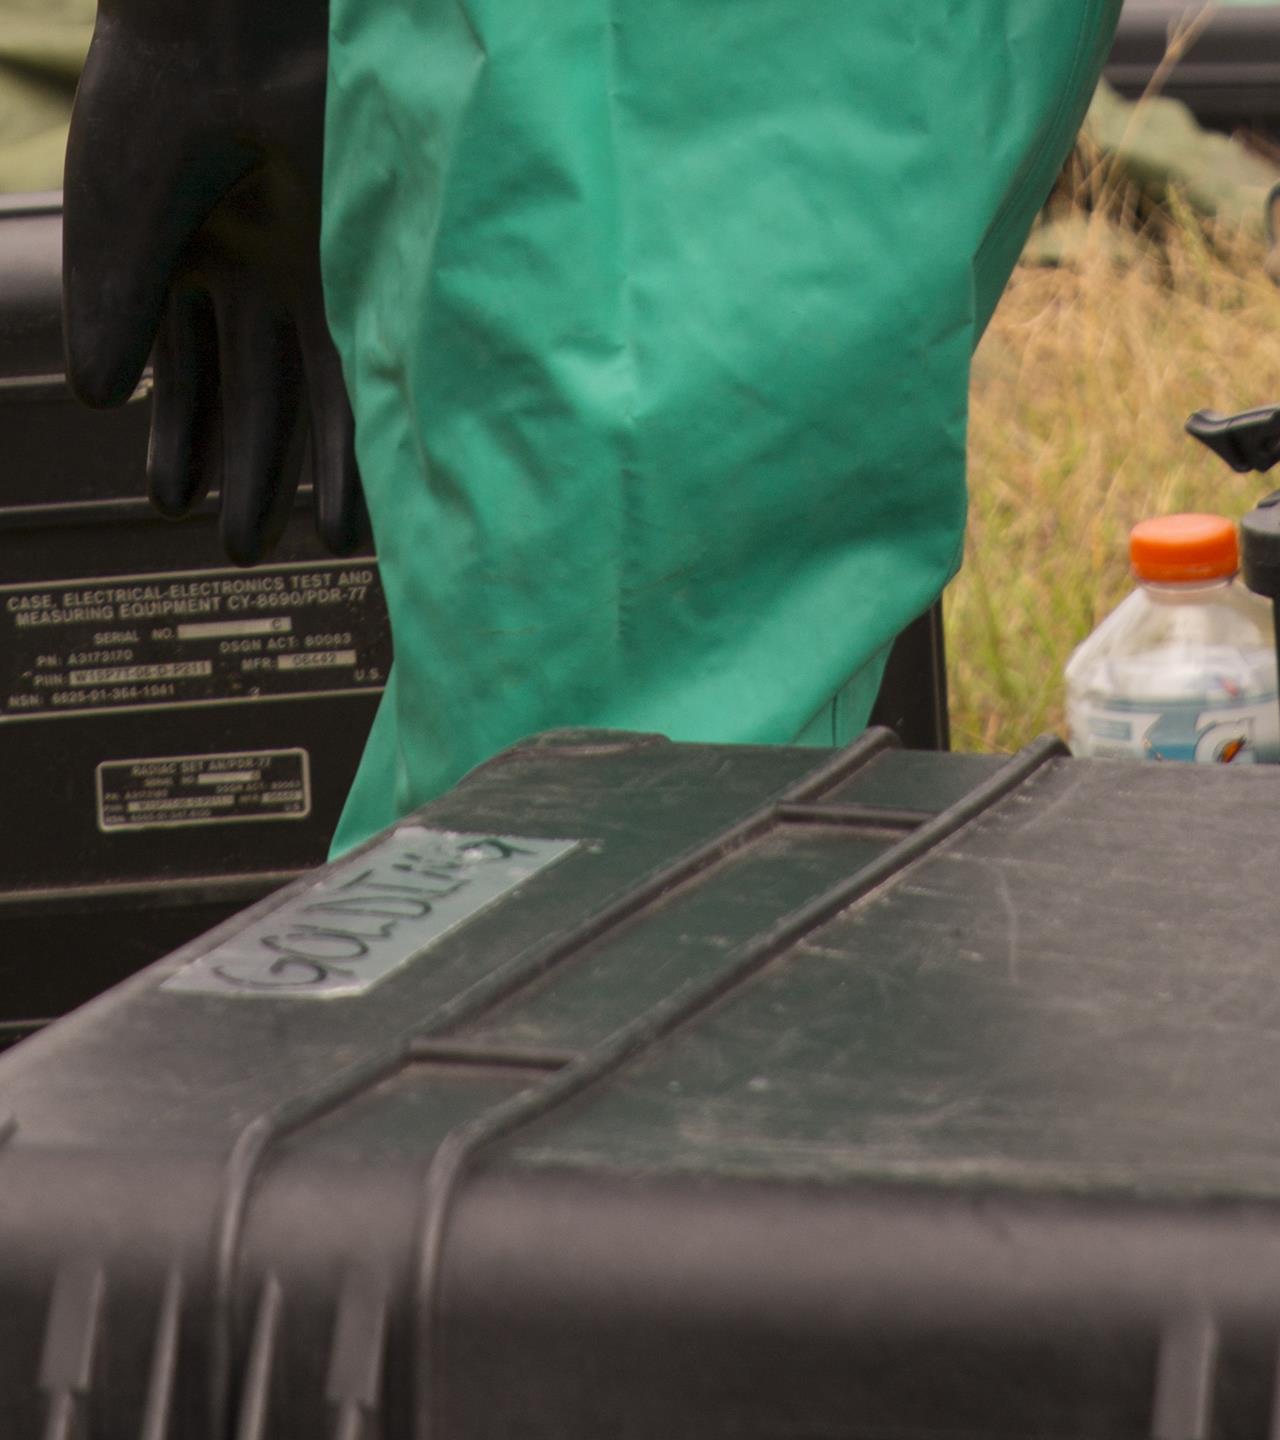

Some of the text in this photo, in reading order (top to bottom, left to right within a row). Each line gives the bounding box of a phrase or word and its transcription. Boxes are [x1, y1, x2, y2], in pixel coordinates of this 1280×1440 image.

[64, 575, 285, 608] ELECTRICAL-ELECTRONICS
[290, 573, 333, 590] TEST
[338, 571, 373, 586] AND
[16, 587, 367, 626] MEASURING EQUIPMENT CY-8690/PDR-77
[94, 630, 140, 645] SERIAL
[220, 640, 262, 654] DSGN
